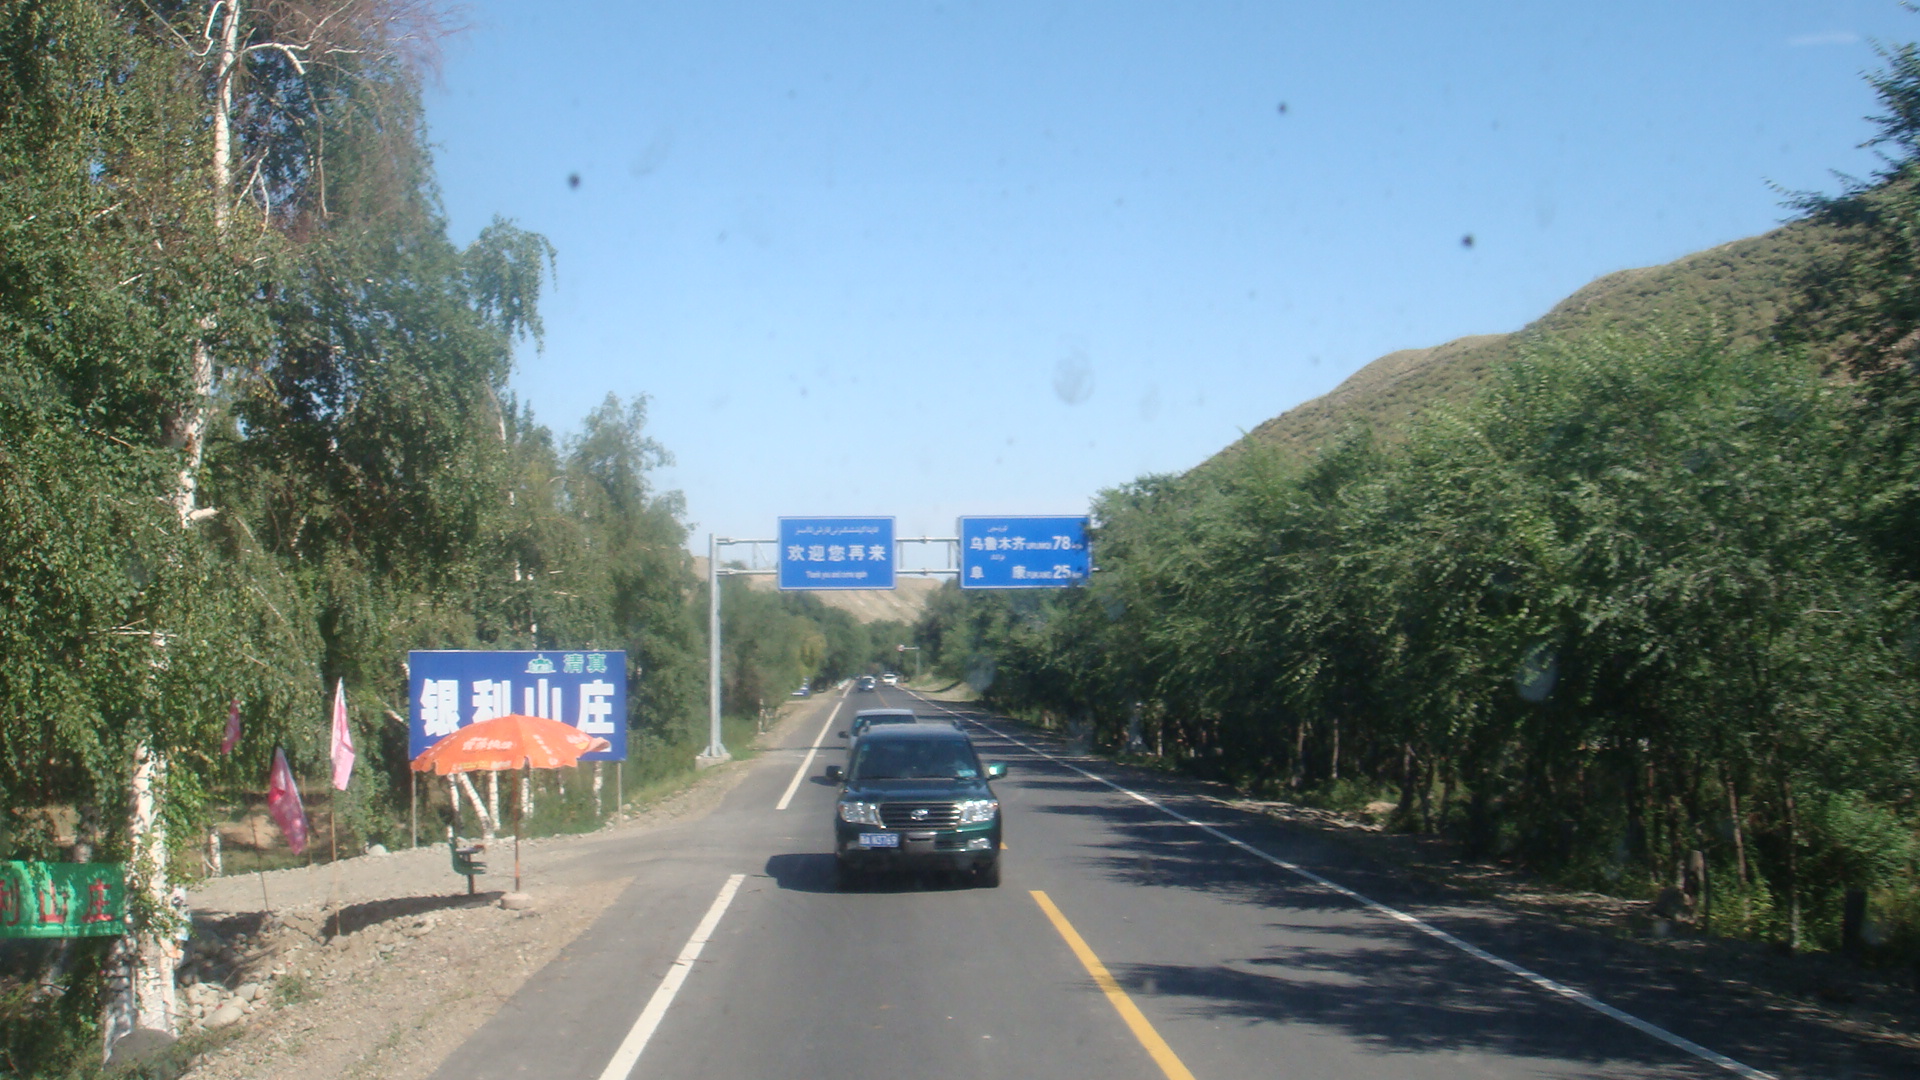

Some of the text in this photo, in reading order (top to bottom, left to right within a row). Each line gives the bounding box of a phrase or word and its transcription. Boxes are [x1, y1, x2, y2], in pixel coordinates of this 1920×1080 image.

[970, 536, 1026, 551] 乌鲁木齐
[1052, 535, 1071, 550] 78
[787, 544, 886, 562] 欢迎您再来
[1053, 565, 1071, 579] 25
[563, 653, 607, 673] 清真
[419, 678, 615, 737] 银利山庄
